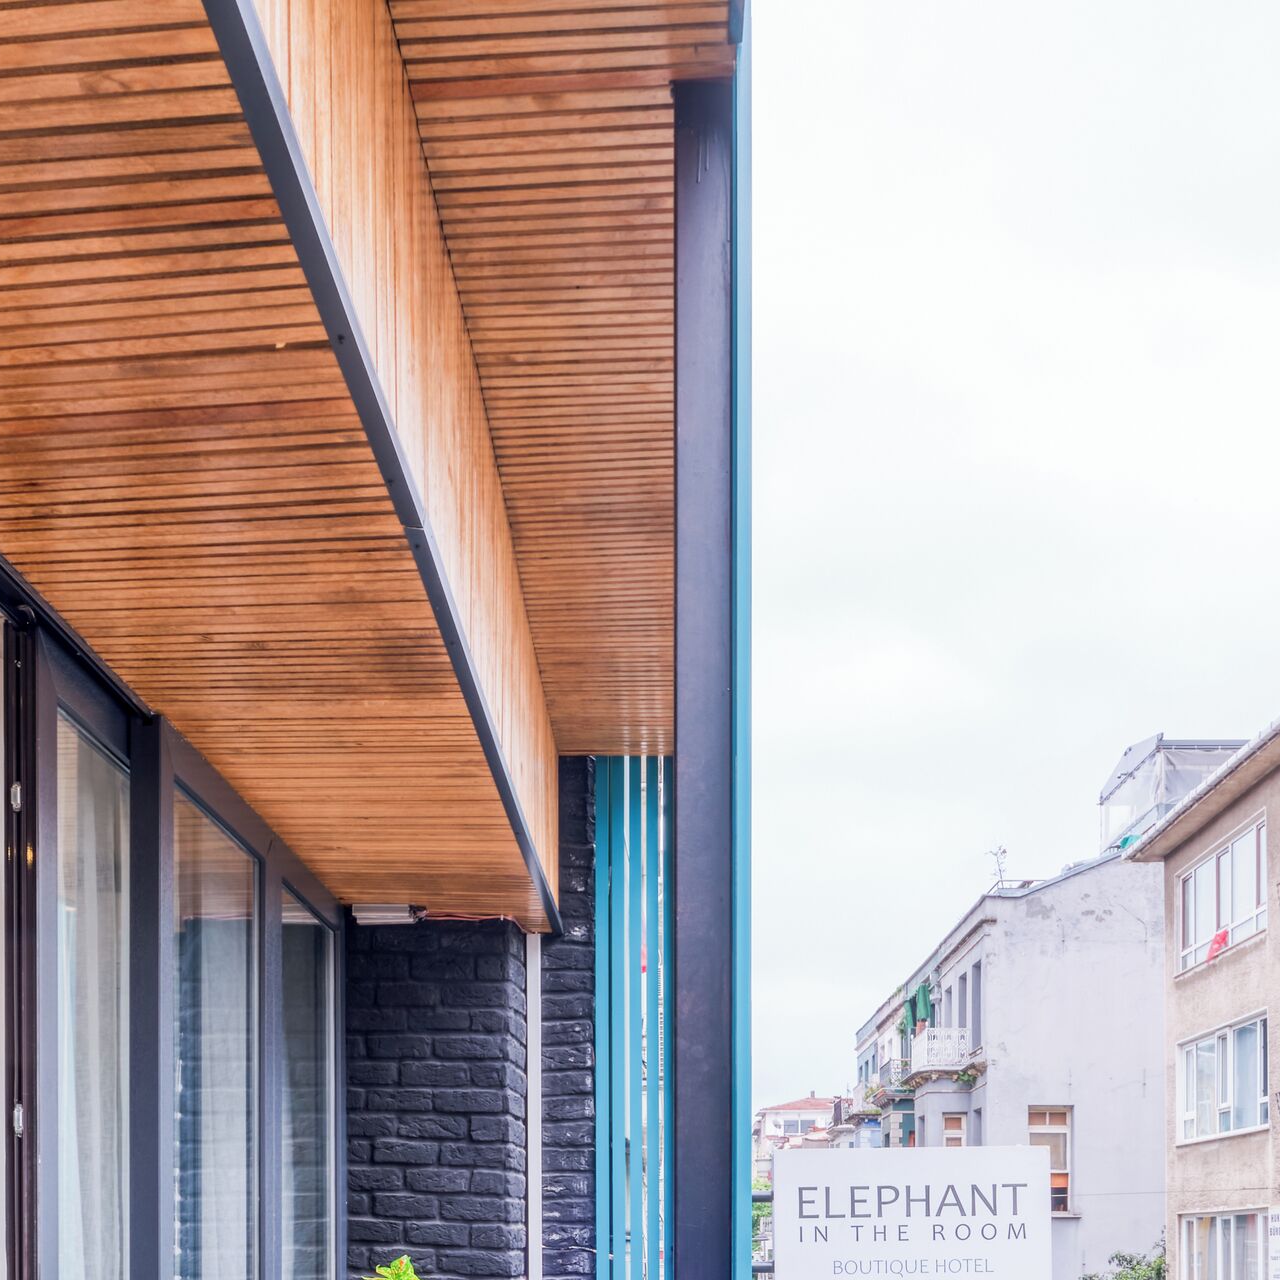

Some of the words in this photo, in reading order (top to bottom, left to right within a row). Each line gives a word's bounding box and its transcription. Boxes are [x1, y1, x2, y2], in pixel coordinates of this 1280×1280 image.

[798, 1183, 1028, 1219] ELEPHANT
[799, 1225, 829, 1243] IN
[851, 1224, 910, 1242] THE
[932, 1222, 1027, 1241] ROOM
[832, 1259, 929, 1278] BOUTIQUE
[935, 1258, 995, 1274] HOTEL
